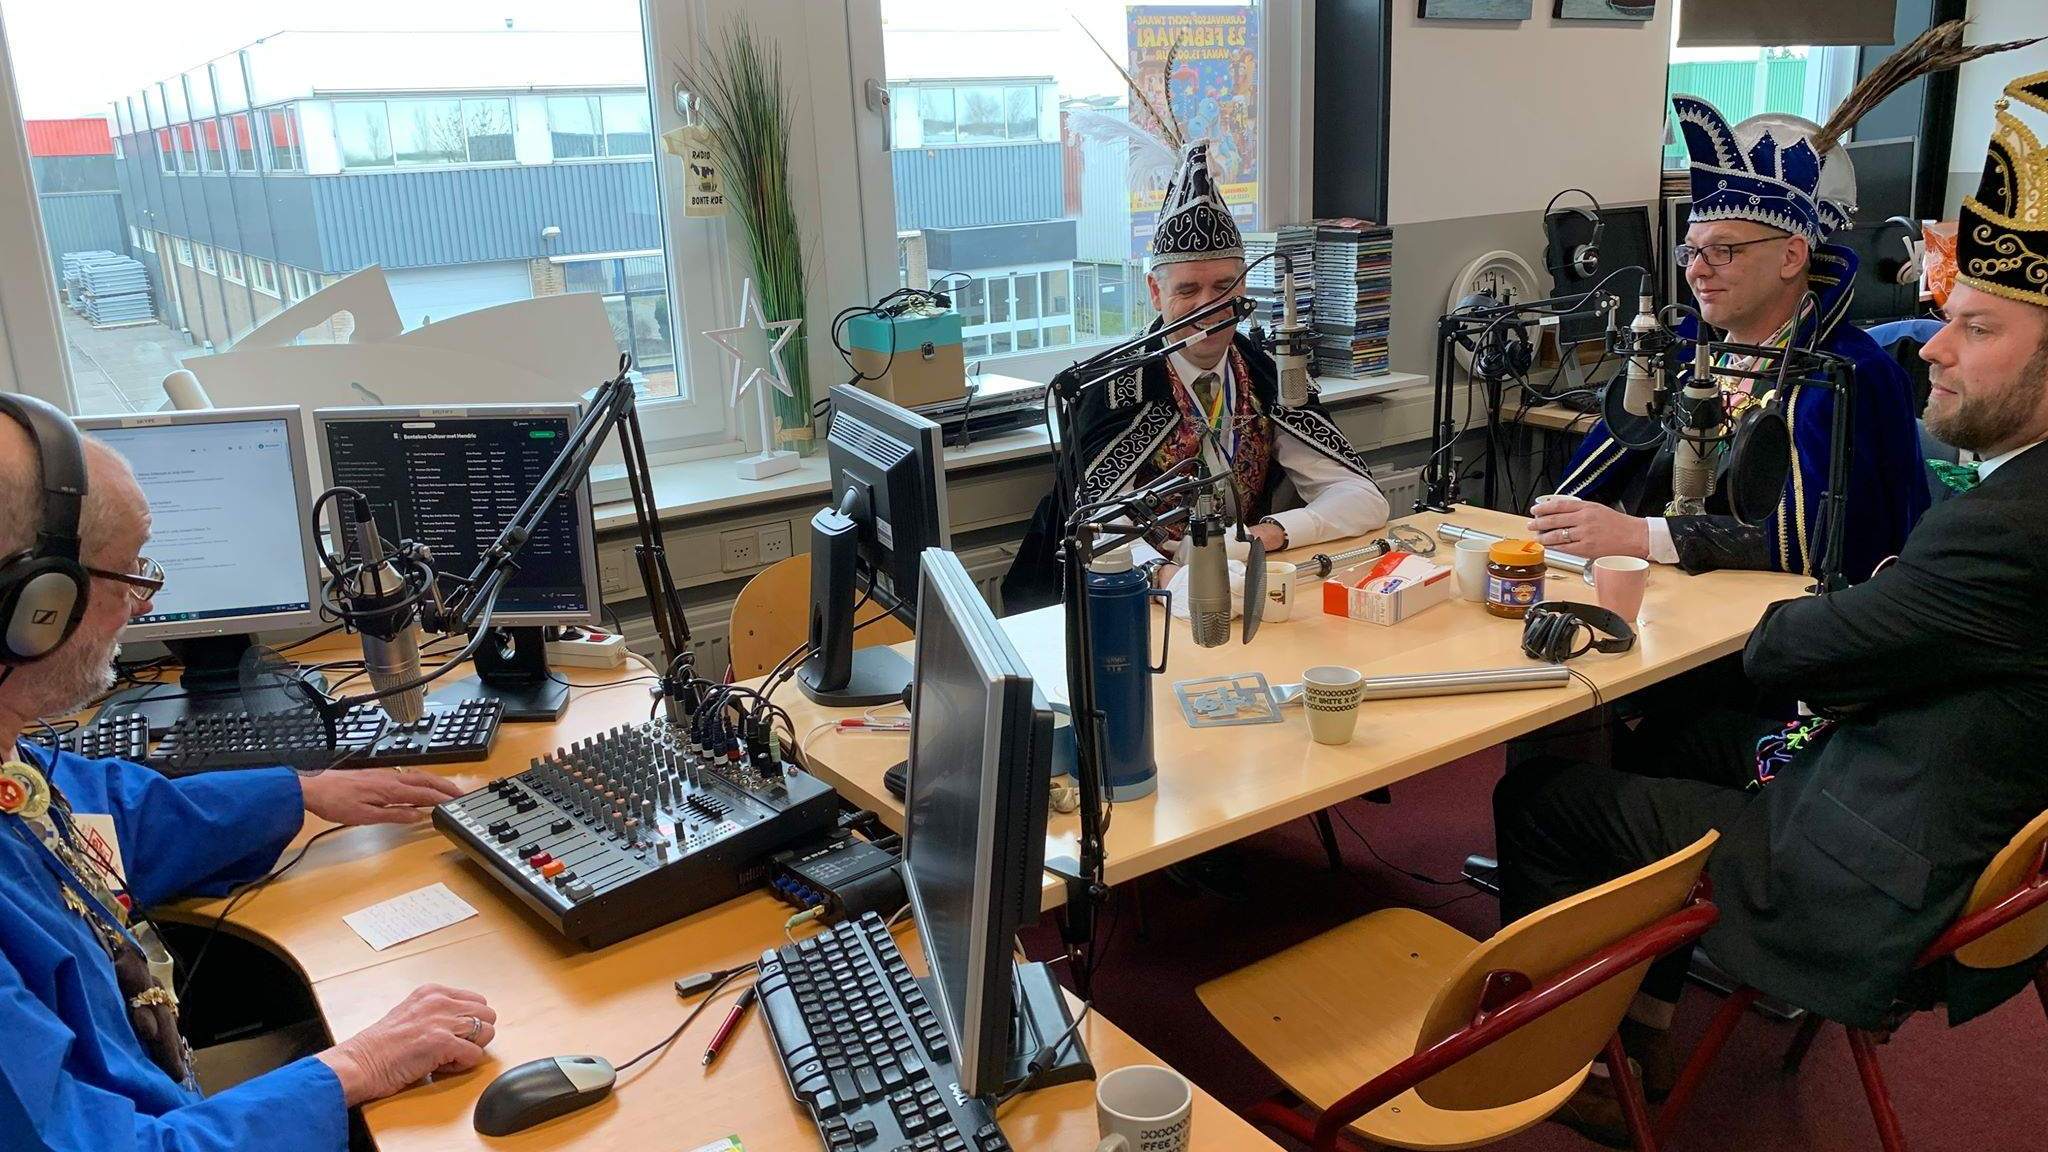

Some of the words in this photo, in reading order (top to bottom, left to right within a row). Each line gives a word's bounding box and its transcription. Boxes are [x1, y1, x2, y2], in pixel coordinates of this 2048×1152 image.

[692, 151, 710, 159] RADIO
[691, 196, 709, 206] BONTE
[710, 196, 723, 205] KOE
[1484, 271, 1495, 282] 12
[1318, 697, 1343, 706] WHITE
[948, 1082, 969, 1108] DELL
[1140, 1138, 1171, 1151] FFEE
